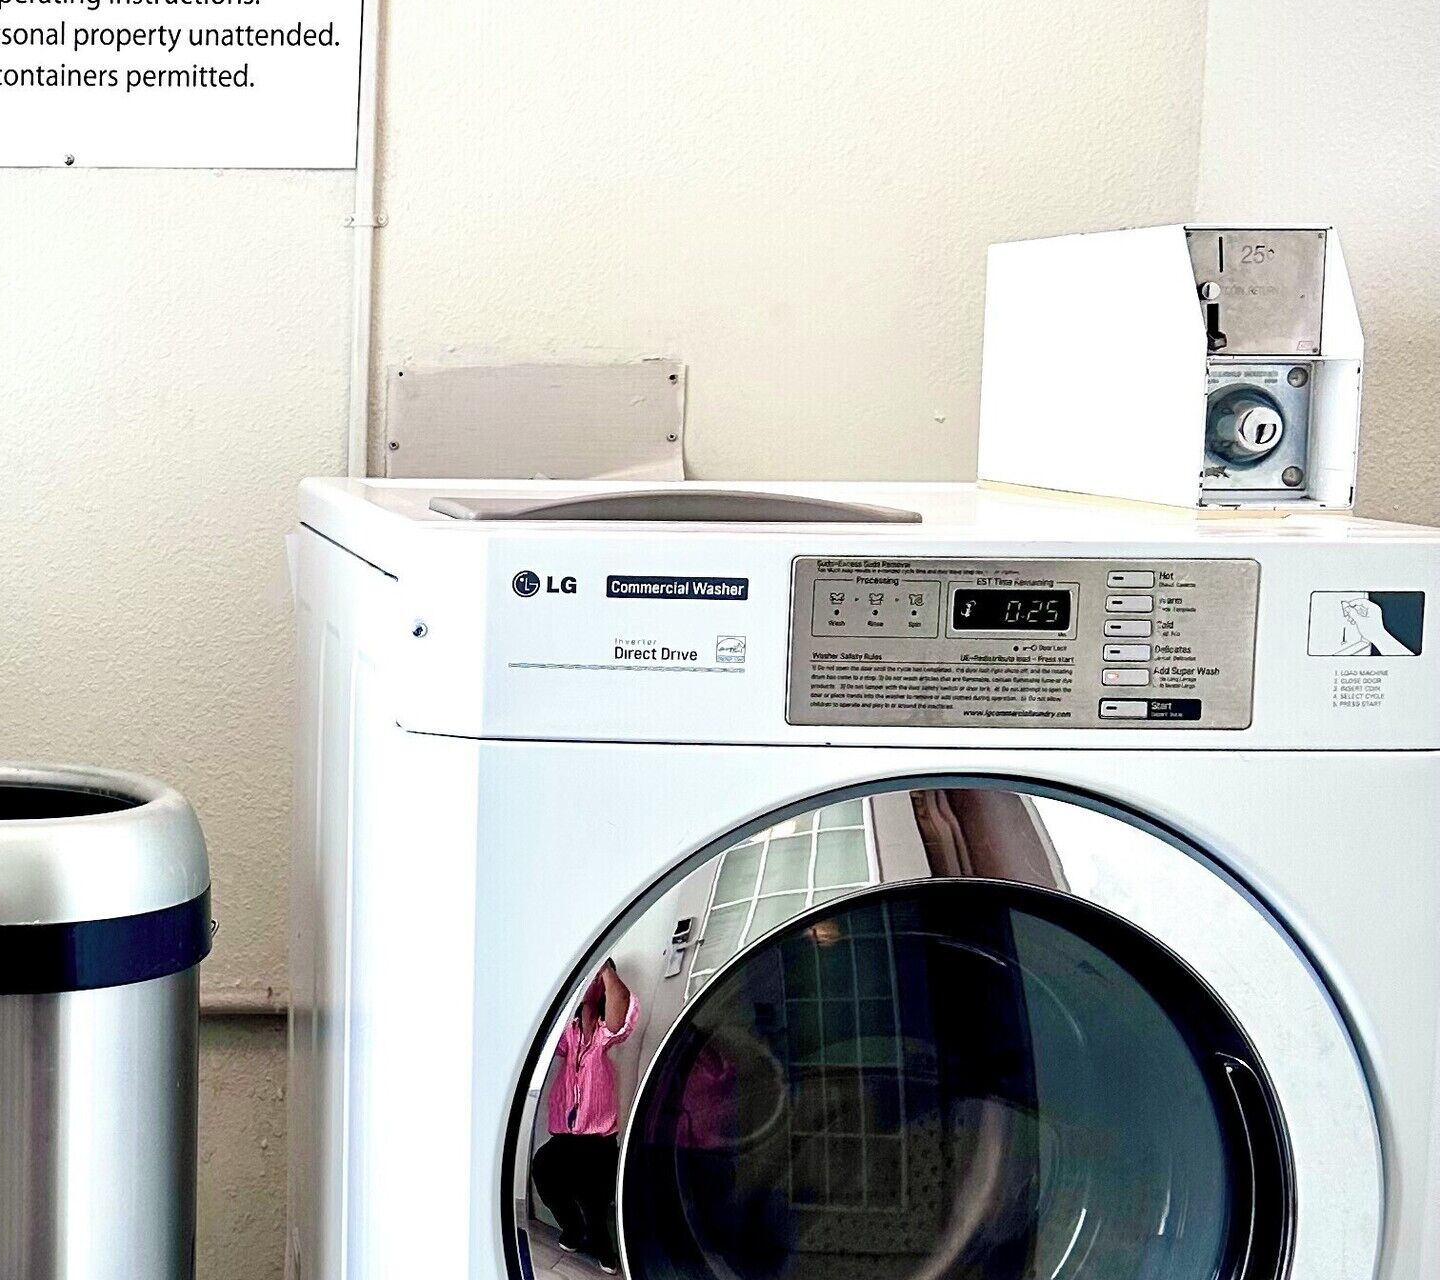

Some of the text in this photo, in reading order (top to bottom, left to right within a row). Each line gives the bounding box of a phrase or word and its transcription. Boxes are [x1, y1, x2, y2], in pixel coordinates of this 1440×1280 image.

[73, 25, 182, 53] property
[189, 21, 340, 47] unattended.
[126, 62, 255, 93] permitted.
[1159, 571, 1174, 580] Hot
[547, 576, 577, 594] LG
[611, 580, 745, 596] Commercial Washer
[976, 578, 991, 586] EST
[994, 578, 1013, 586] Time
[614, 646, 698, 661] Direct Drive
[1154, 644, 1192, 654] Delicates
[1171, 666, 1195, 676] Super
[1197, 667, 1220, 676] Wash
[1150, 701, 1172, 711] Start
